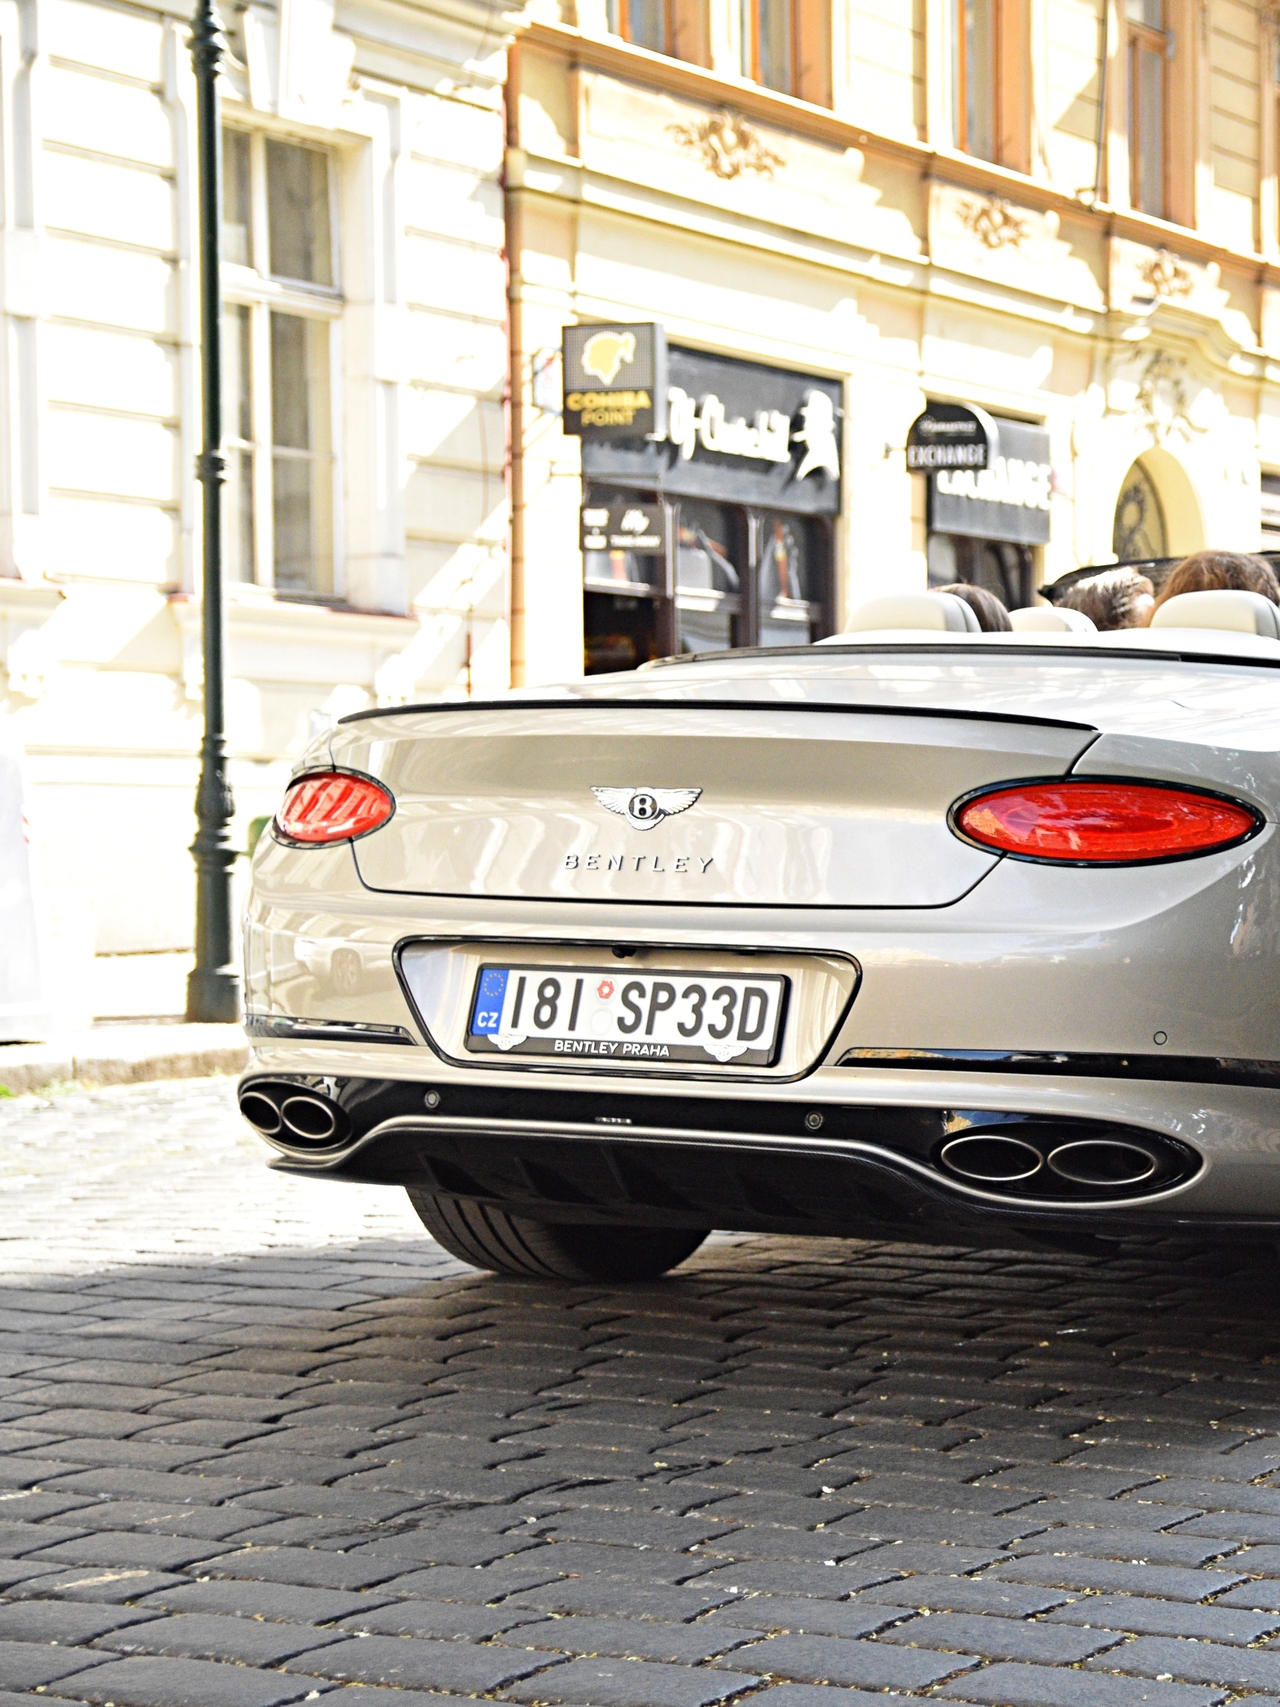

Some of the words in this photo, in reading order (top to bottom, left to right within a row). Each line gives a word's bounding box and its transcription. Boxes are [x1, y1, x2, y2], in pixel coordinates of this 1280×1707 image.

[567, 390, 651, 411] COHIBA
[581, 409, 636, 427] POINT
[907, 443, 987, 467] EXCHANGE
[564, 853, 714, 873] BENTLEY
[476, 1011, 499, 1028] CZ
[616, 980, 769, 1041] SP33D
[554, 1039, 619, 1055] BENTLEY
[622, 1044, 670, 1057] PRAHA
